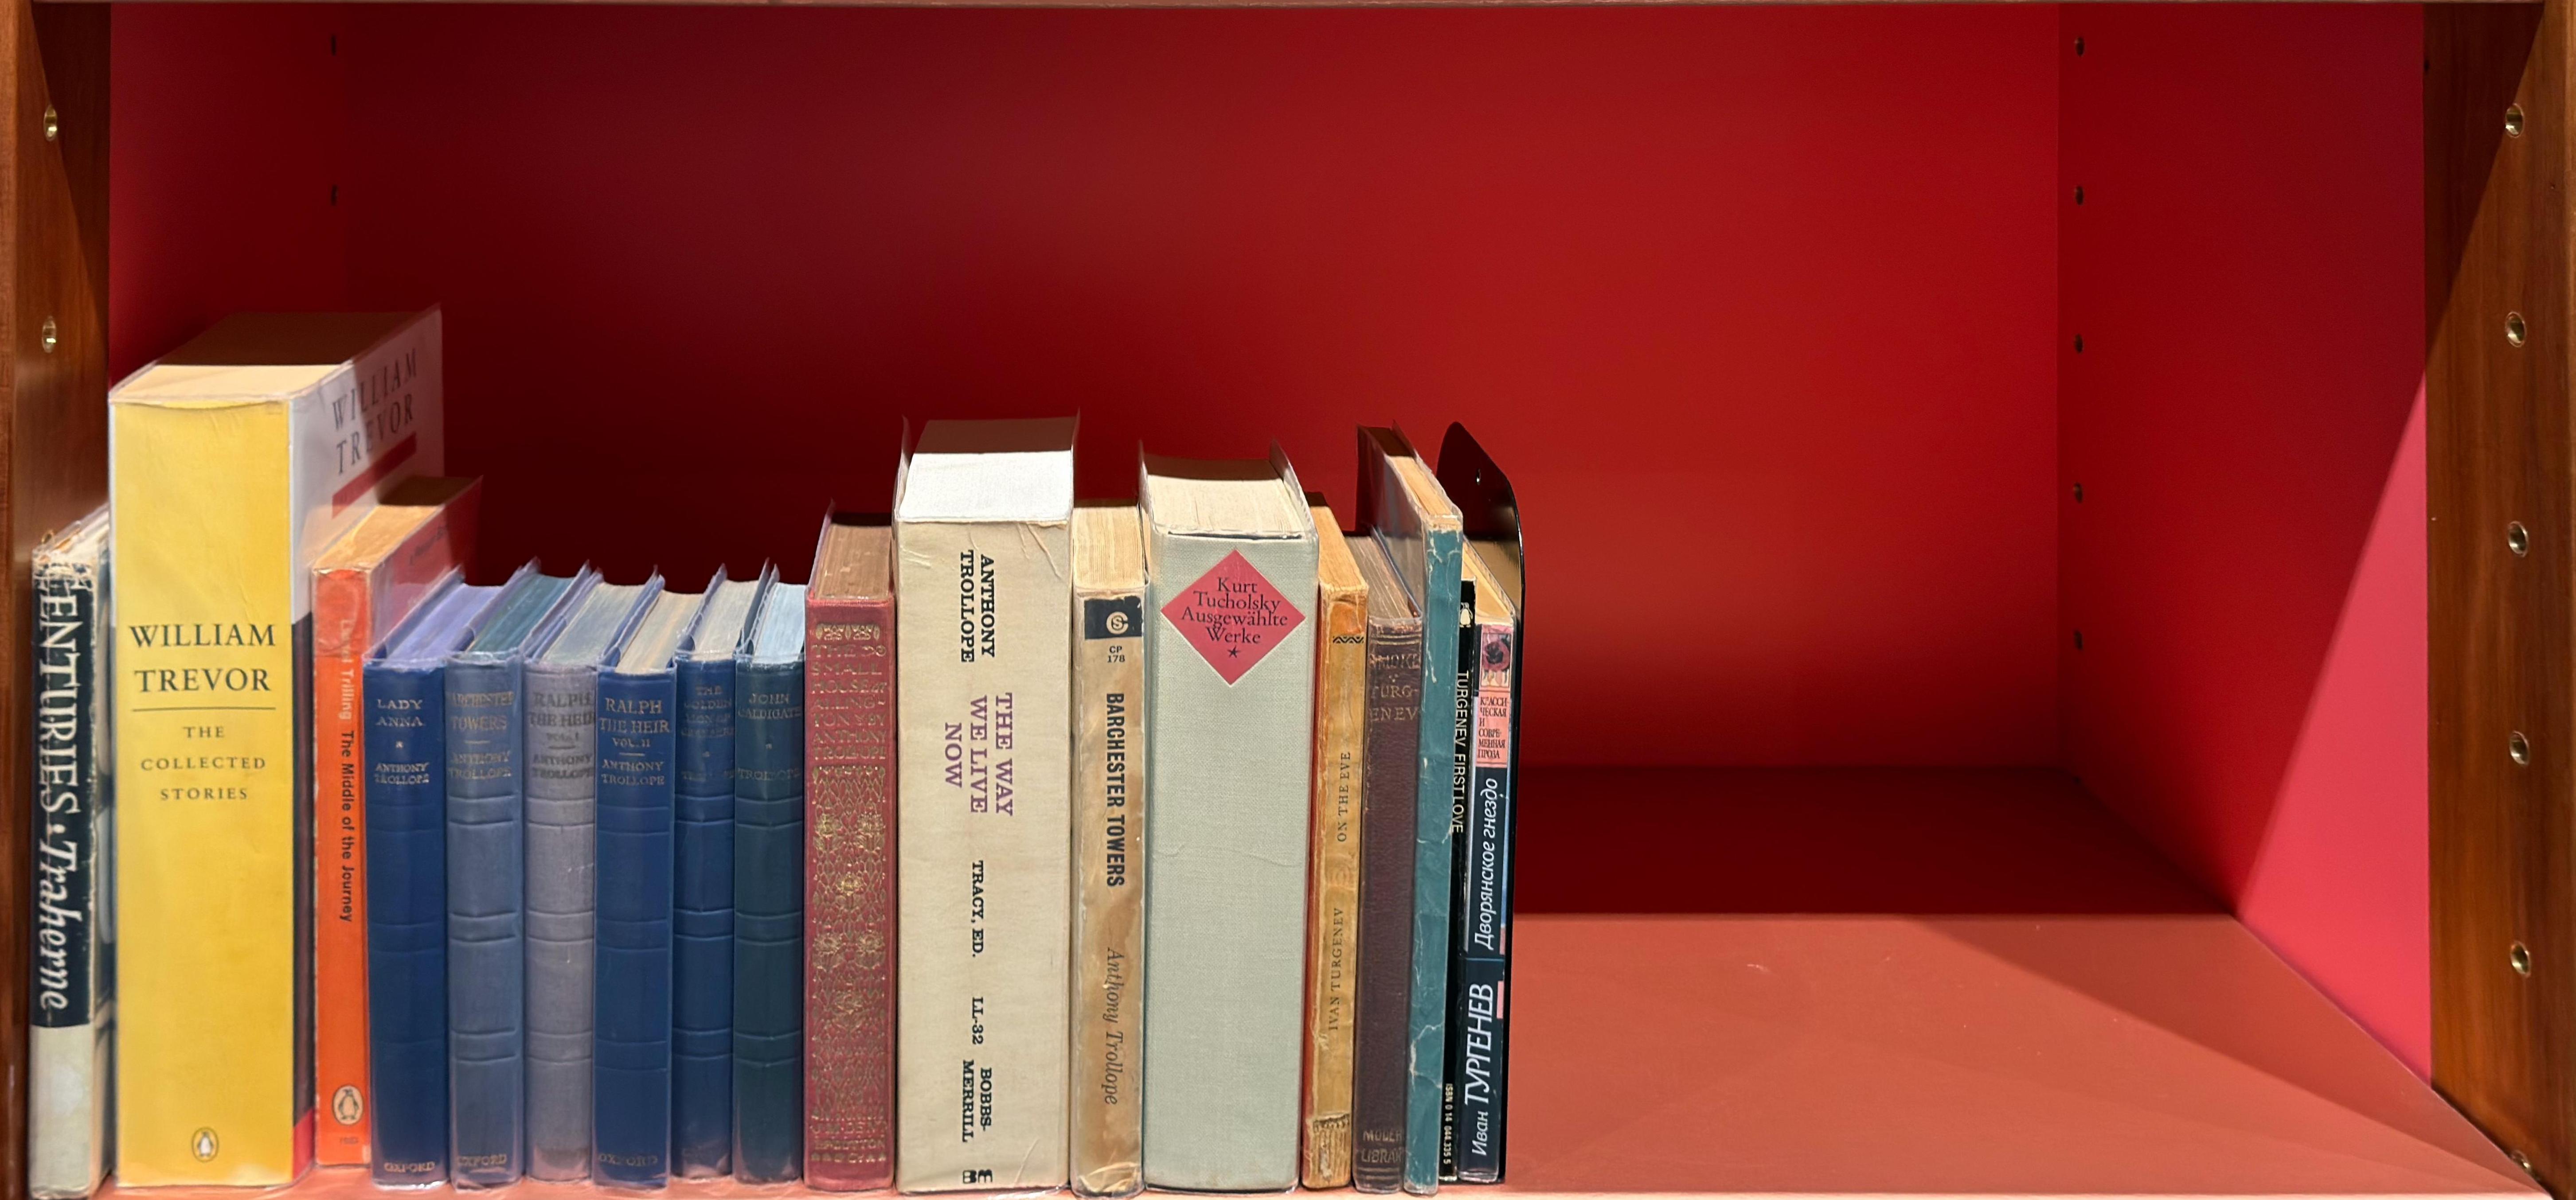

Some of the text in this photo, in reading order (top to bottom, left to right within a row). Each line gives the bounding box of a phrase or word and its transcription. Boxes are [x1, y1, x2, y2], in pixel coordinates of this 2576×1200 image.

[332, 348, 417, 430] WILLIAM
[336, 394, 413, 475] TREVOR
[1217, 577, 1258, 593] Kurt
[960, 549, 975, 663] TROLLOPE
[980, 554, 995, 657] ANTHONY
[1193, 590, 1281, 614] Tucholsky
[1181, 606, 1288, 632] Ausgewählte
[129, 623, 276, 648] WILLIAM
[1205, 626, 1261, 644] Werke
[1107, 655, 1126, 663] 178
[1109, 645, 1122, 654] CP
[134, 667, 272, 693] TREVOR
[338, 668, 354, 720] Trilling
[377, 699, 422, 710] LADY
[605, 697, 664, 714] RALPH
[375, 716, 424, 727] ANNA
[1479, 718, 1485, 727] И
[1480, 707, 1507, 717] ЧЕСКАЯ
[183, 726, 226, 739] THE
[631, 719, 670, 734] HEIR
[341, 731, 354, 757] The
[944, 722, 962, 788] NOW
[970, 695, 988, 813] WE LIVE
[996, 692, 1013, 816] THE WAY
[1451, 670, 1469, 834] TURGENEV FIRST LOVE
[1478, 739, 1505, 748] МЕННАЯ
[1478, 749, 1500, 759] ПРОЗА
[140, 756, 266, 771] COLLECTED
[602, 759, 664, 772] ANTHONY
[160, 787, 248, 800] STORIES
[341, 763, 355, 811] Middle
[1106, 693, 1125, 887] BARCHESTER TOWERS
[1336, 753, 1351, 843] ON THE EVE
[341, 817, 355, 830] of
[341, 837, 355, 859] the
[1474, 778, 1498, 951] Дворянское гнездо
[339, 865, 354, 922] Journey
[970, 860, 984, 958] TRACY, ED.
[39, 839, 82, 1009] Traherne
[1328, 908, 1344, 1032] IVAN TURGENEV
[972, 996, 984, 1045] LL-32
[1102, 947, 1126, 1105] Anthony Trollope
[1464, 984, 1493, 1156] Иван ТУРГЕНЕВ
[962, 1060, 974, 1143] MERRILL
[980, 1068, 992, 1131] BOBBS-
[1445, 1083, 1454, 1102] ISBN
[1444, 1112, 1453, 1122] 14
